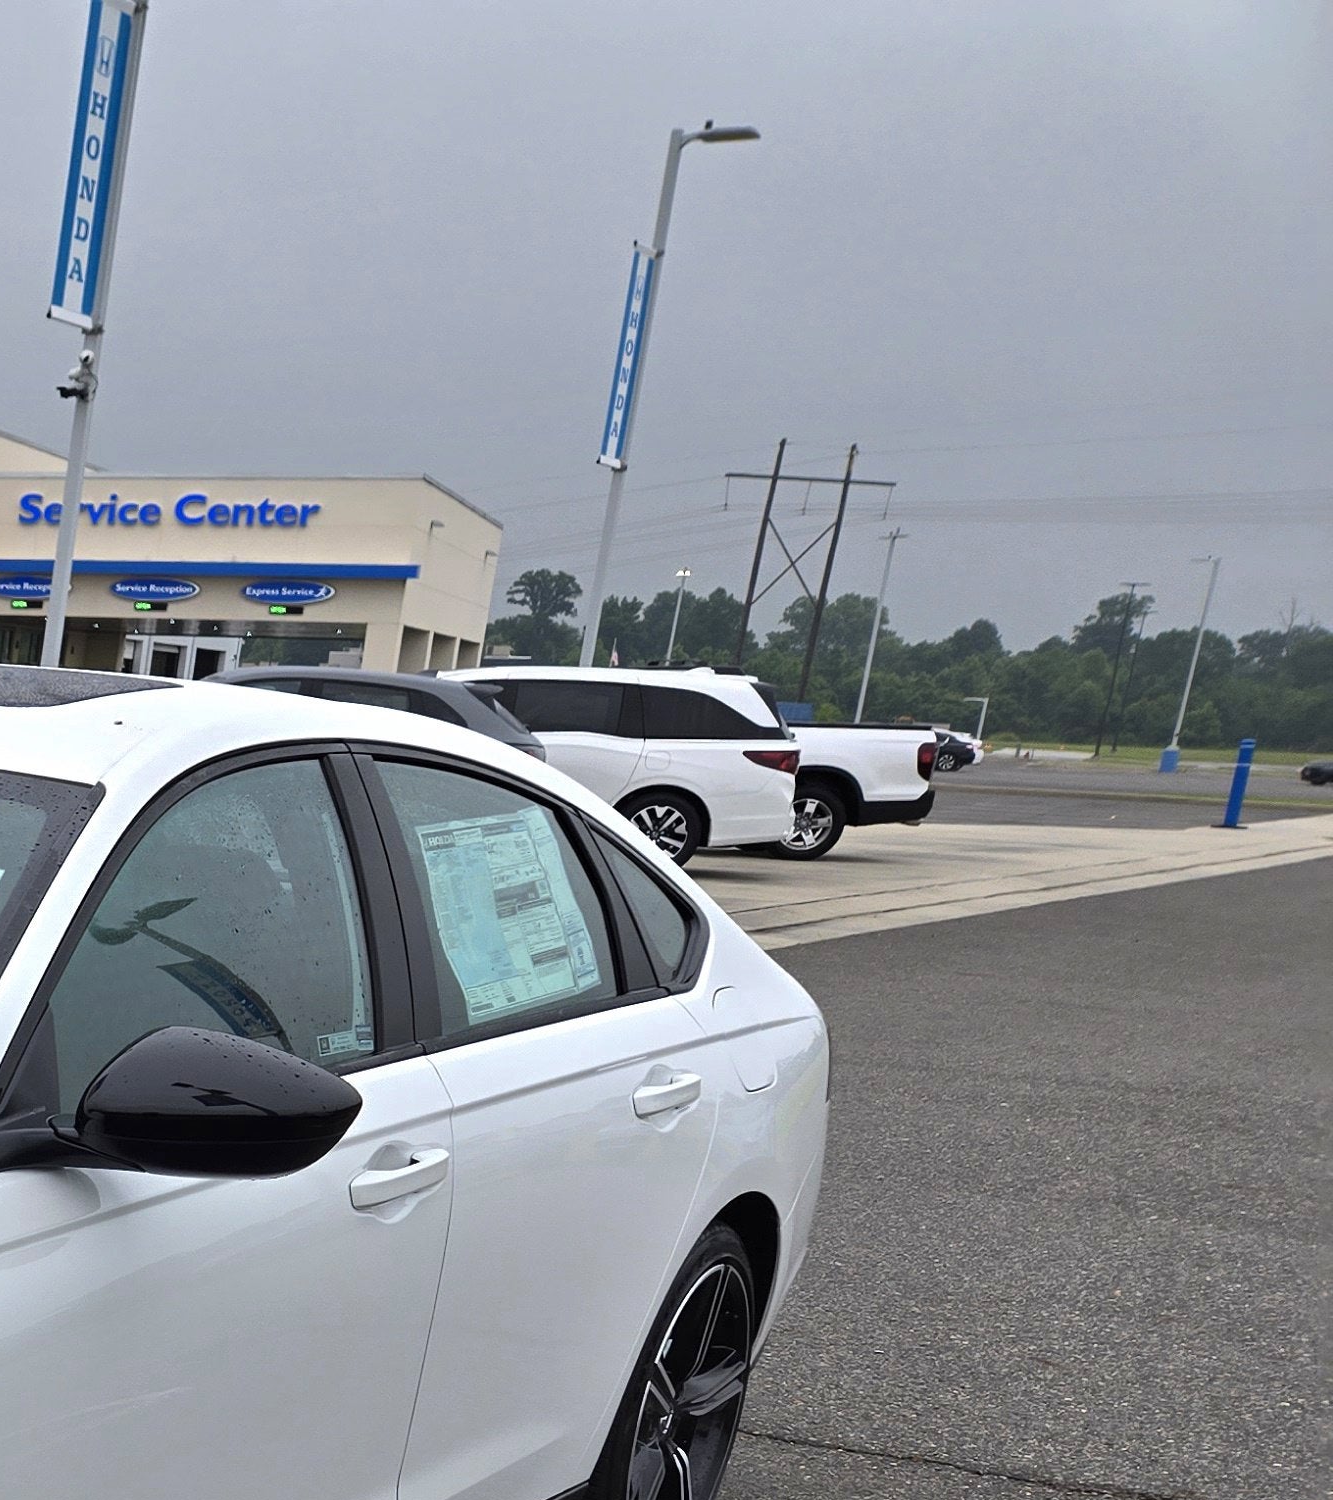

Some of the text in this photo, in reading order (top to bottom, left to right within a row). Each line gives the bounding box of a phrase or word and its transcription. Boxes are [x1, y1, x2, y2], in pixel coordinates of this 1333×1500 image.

[68, 91, 108, 283] HONDA
[609, 311, 639, 438] HONDA
[174, 493, 321, 528] Center
[23, 582, 52, 592] Recep
[115, 582, 193, 594] Service Reception
[245, 586, 314, 596] Express Service
